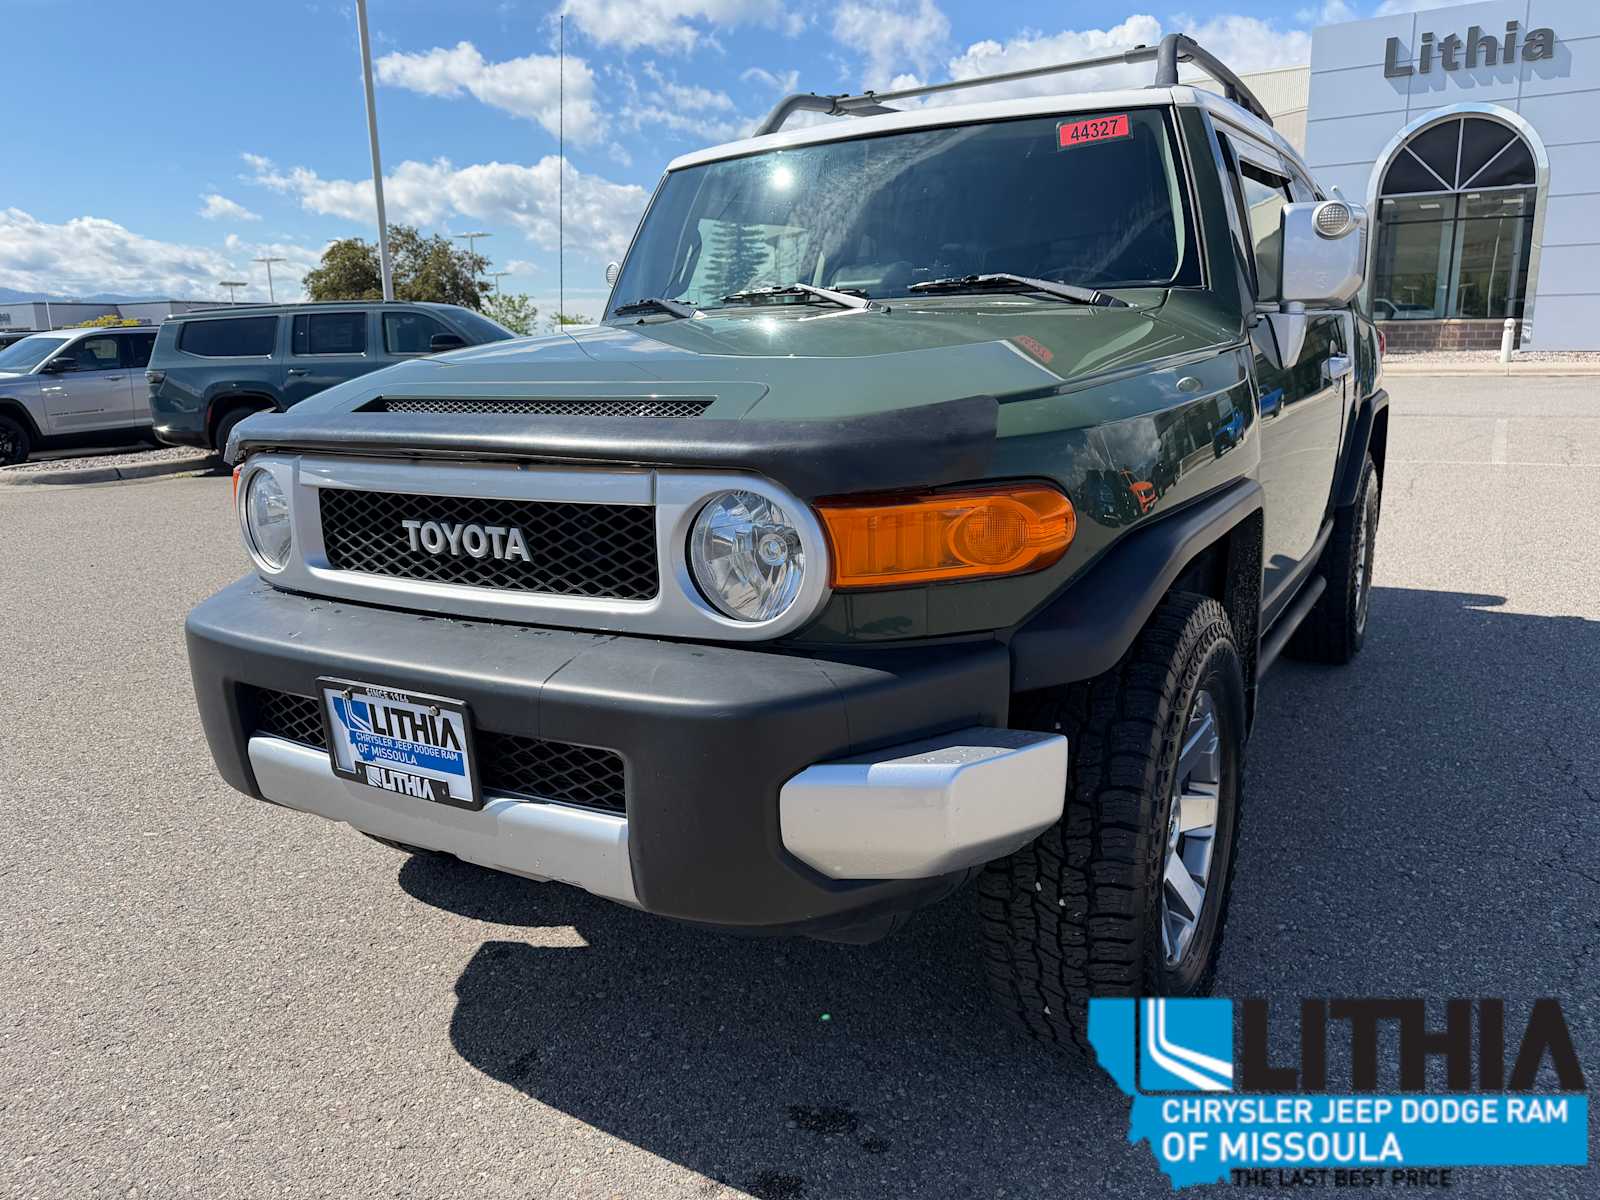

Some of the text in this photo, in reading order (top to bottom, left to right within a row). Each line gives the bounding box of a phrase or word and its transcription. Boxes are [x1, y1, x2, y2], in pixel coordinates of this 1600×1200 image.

[1384, 20, 1555, 78] Lithia
[1071, 119, 1118, 141] 44327
[401, 519, 532, 562] TOYOTA
[369, 703, 462, 751] LITHIA
[355, 732, 459, 761] CHRYSLER JEEP DODGE RAM
[358, 743, 418, 765] OF MISSOULA
[380, 768, 435, 801] LITHIA
